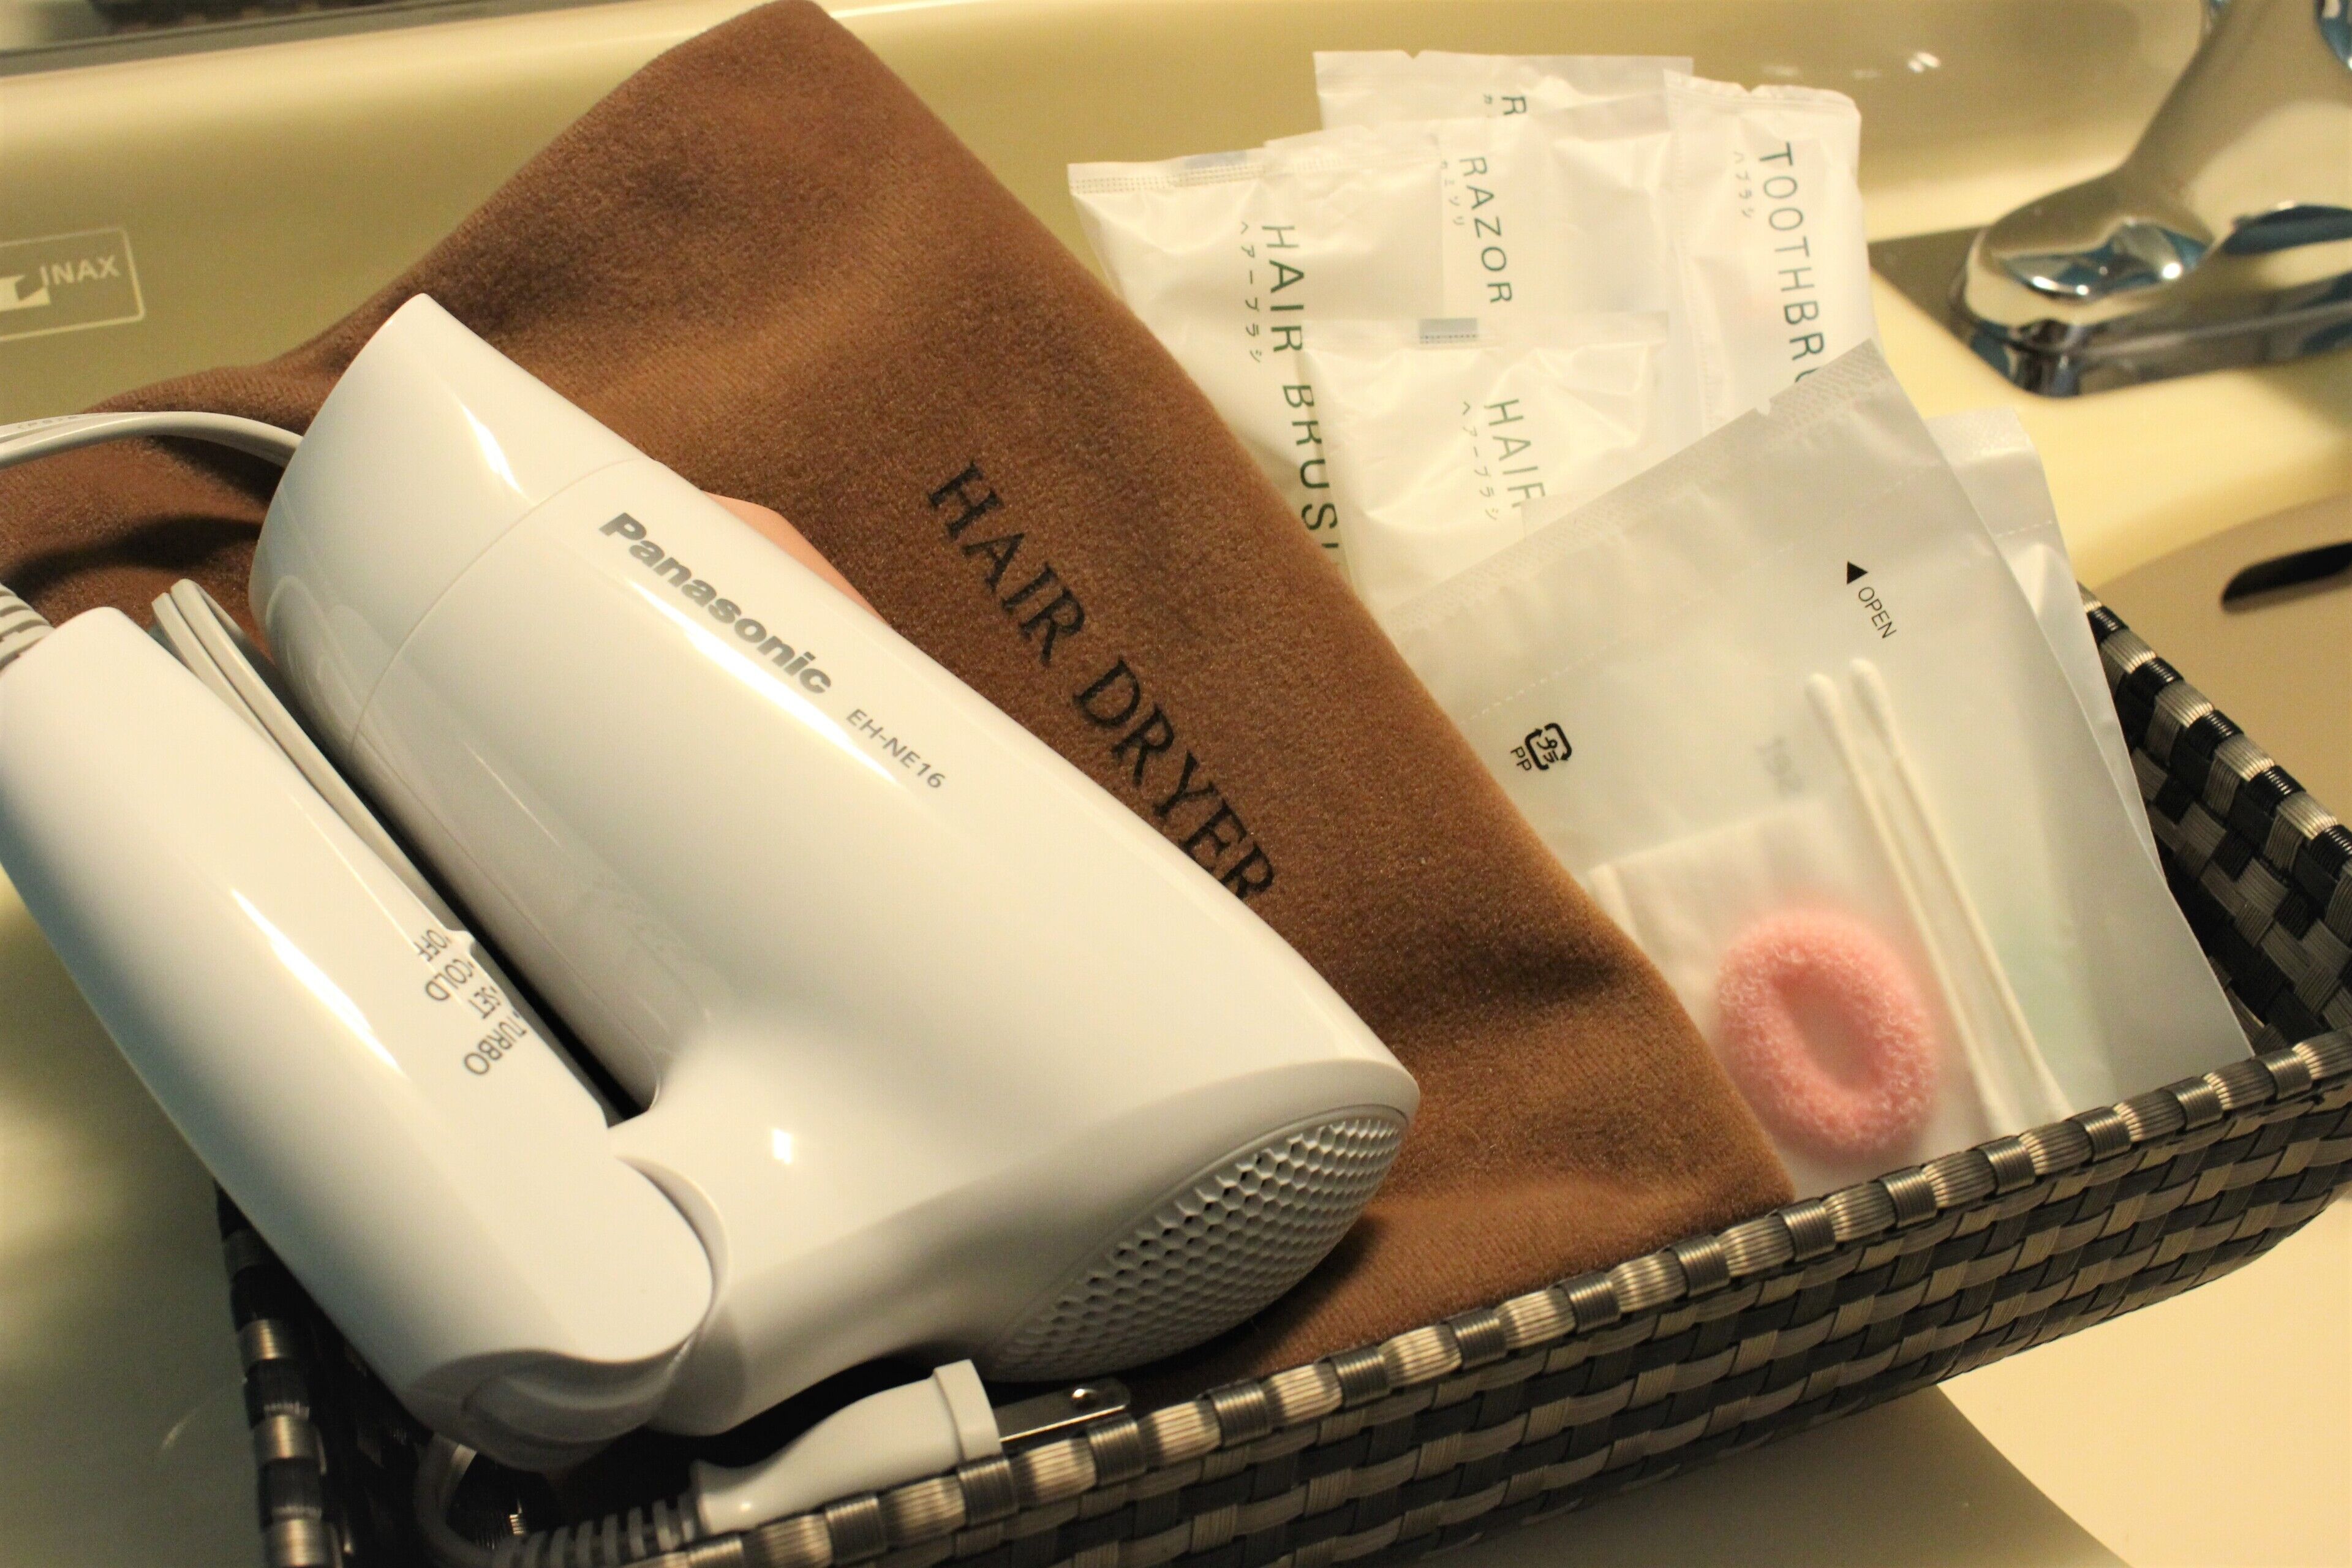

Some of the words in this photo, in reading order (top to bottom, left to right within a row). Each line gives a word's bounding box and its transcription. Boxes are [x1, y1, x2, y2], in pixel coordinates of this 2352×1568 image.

[39, 254, 122, 287] INAX
[1459, 157, 1513, 304] RAZOR
[1240, 222, 1263, 363] ヘアーブラシ
[1261, 224, 1306, 352] HAIR
[1282, 384, 1341, 549] BRUS
[1461, 401, 1499, 521] ヘアーブラシ
[598, 512, 832, 695] Panasonic
[845, 708, 947, 789] EH-NE16
[1858, 586, 1897, 639] OPEN
[927, 459, 1086, 666] HAIR
[1074, 658, 1276, 899] DRYER
[1510, 745, 1532, 771] PP
[415, 929, 448, 962] OFF
[425, 959, 474, 1001] COLD
[464, 1016, 527, 1075] TURBO
[469, 986, 501, 1019] SET
